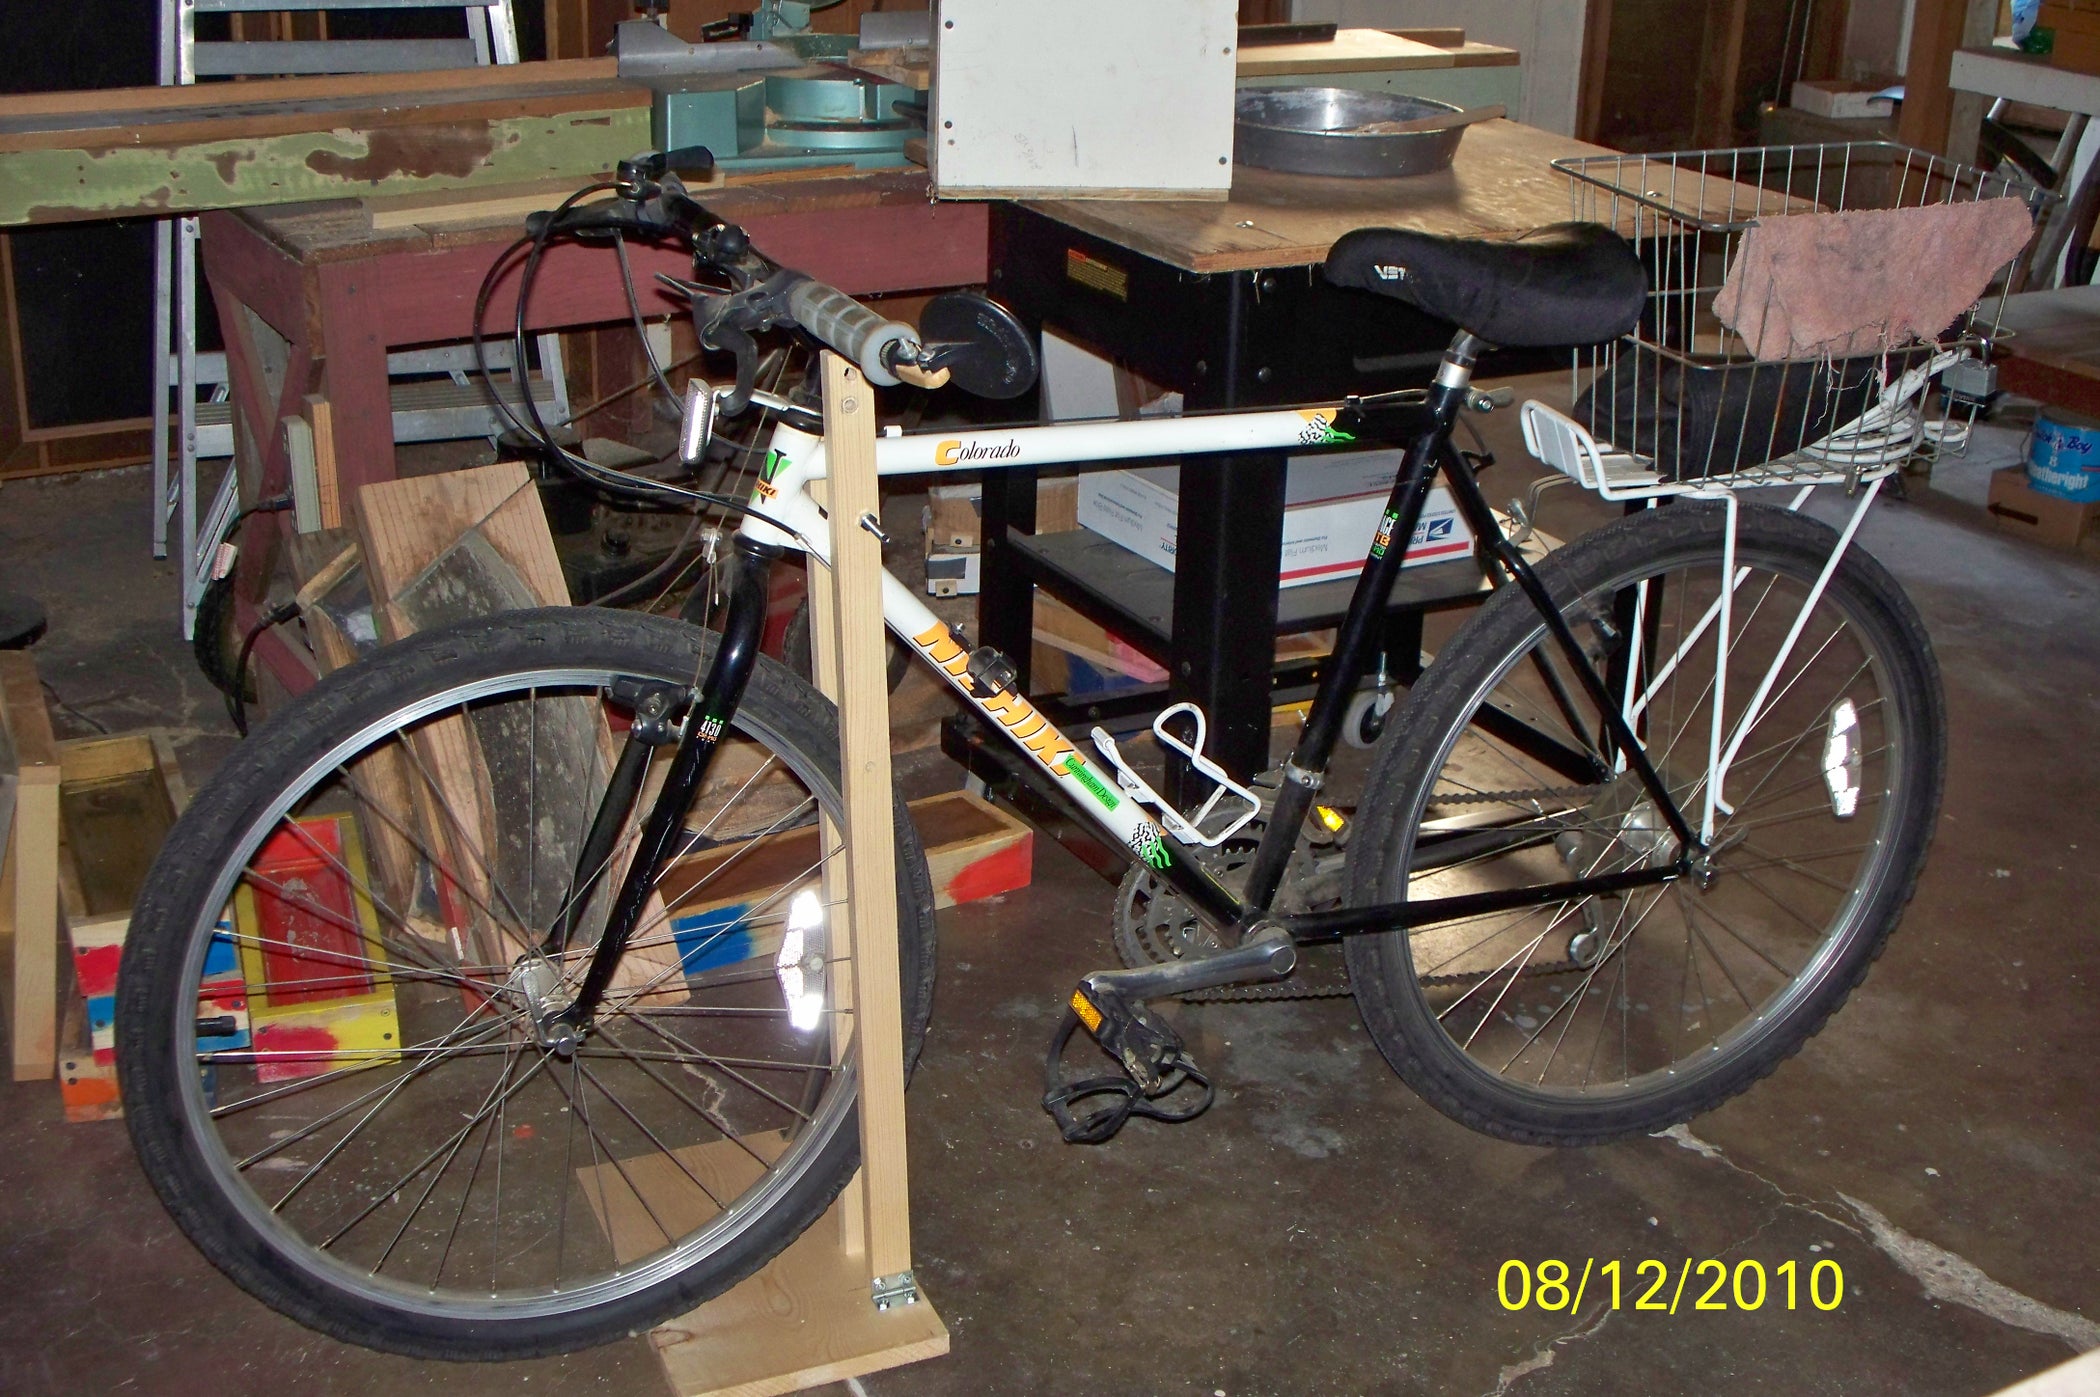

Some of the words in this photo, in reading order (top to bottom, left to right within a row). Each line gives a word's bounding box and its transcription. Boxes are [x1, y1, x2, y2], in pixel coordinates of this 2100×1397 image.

[935, 439, 1021, 466] Colorado
[2066, 436, 2093, 455] Boy
[700, 720, 722, 736] 4130
[1064, 756, 1102, 794] Cunningham
[1095, 785, 1118, 810] Design
